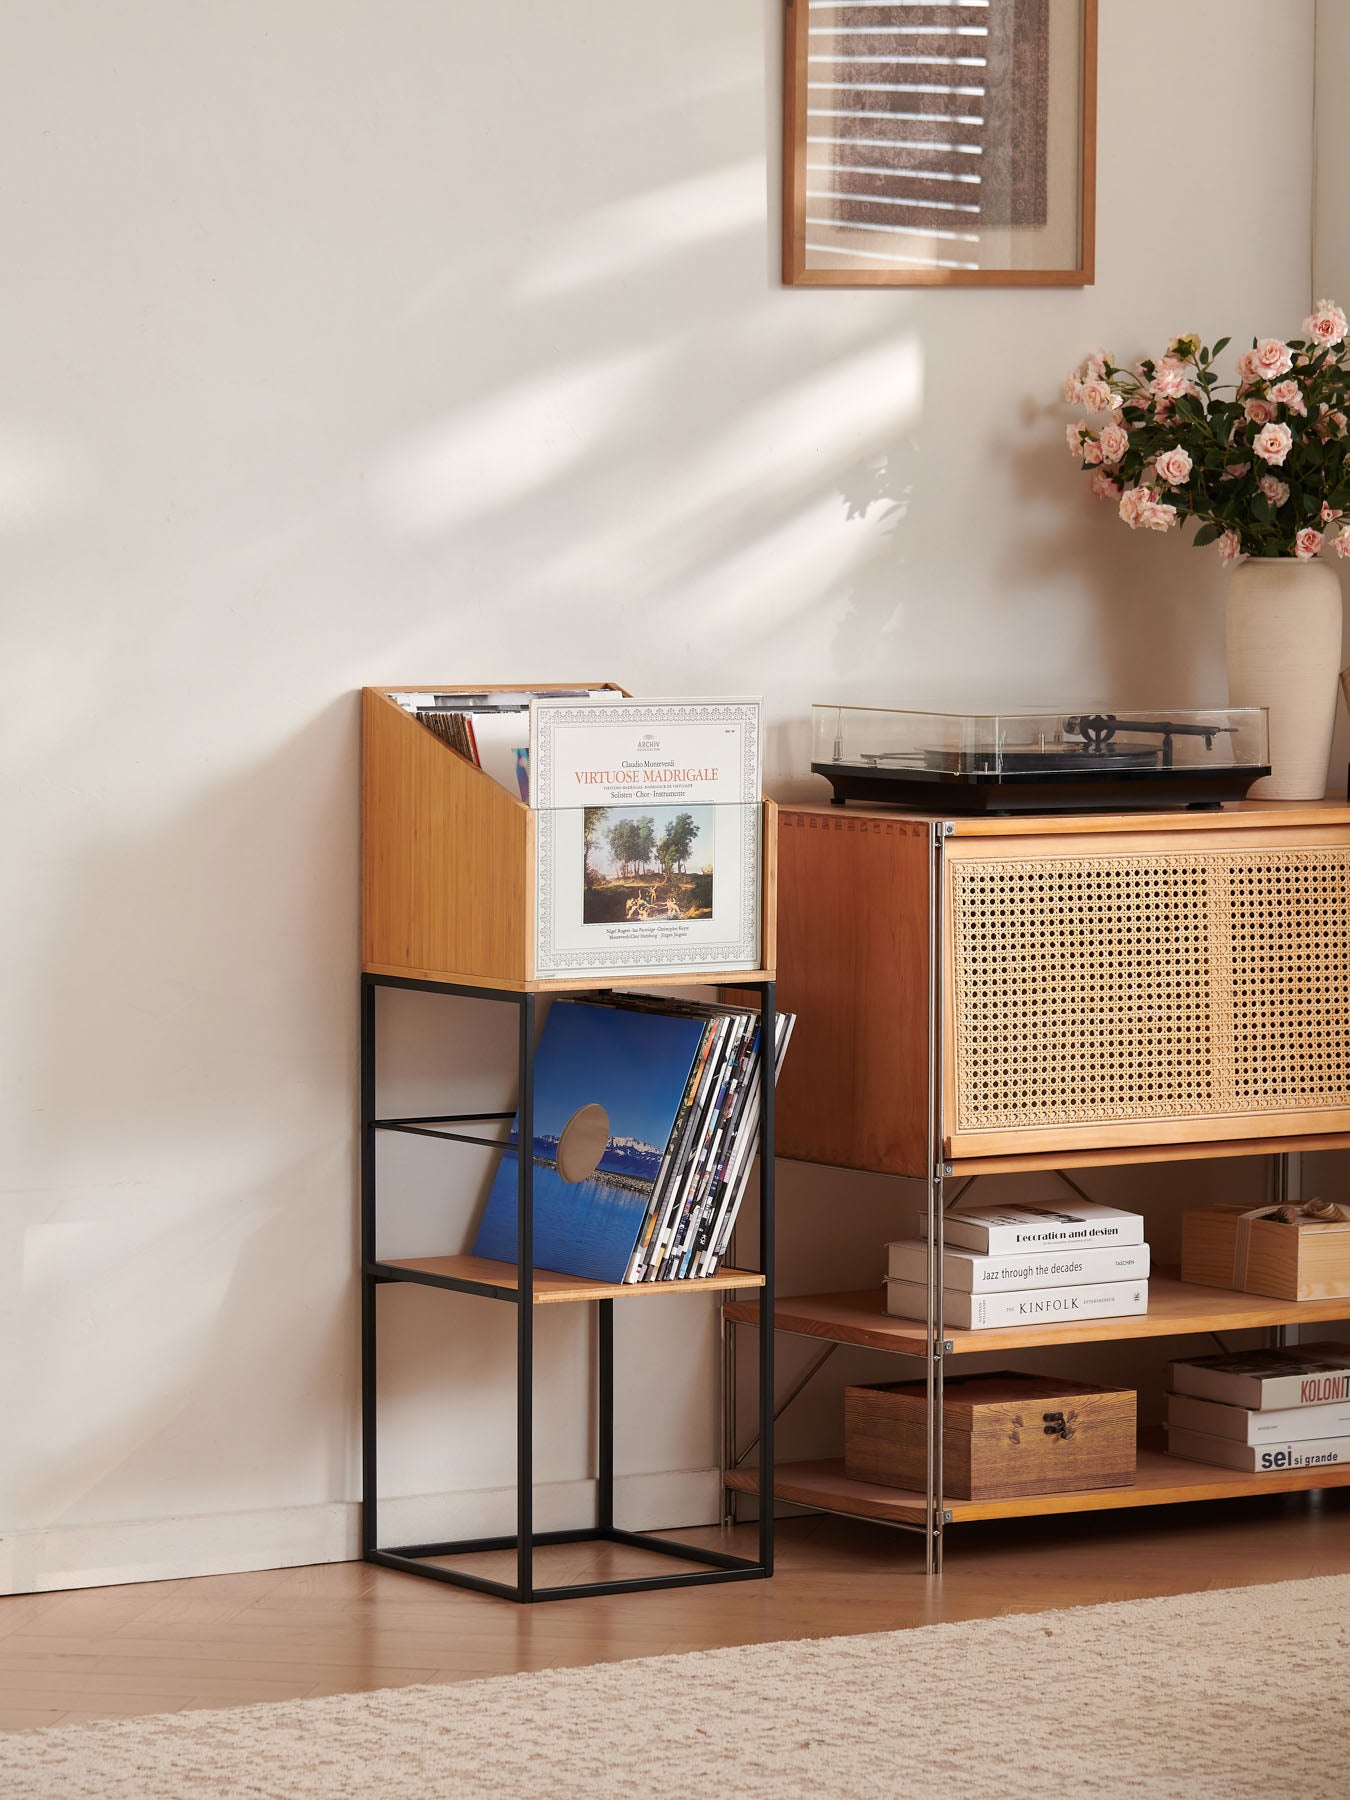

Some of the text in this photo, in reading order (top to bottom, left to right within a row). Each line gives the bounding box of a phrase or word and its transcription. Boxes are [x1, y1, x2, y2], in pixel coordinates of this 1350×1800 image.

[575, 768, 719, 784] VIRTUOSE MADRIGALE
[610, 790, 686, 799] Solisten Chor Instrumente
[1016, 1233, 1066, 1243] Decoration
[1068, 1229, 1087, 1238] and
[1089, 1227, 1119, 1237] design
[982, 1262, 1083, 1280] Jazz through the decades
[1019, 1298, 1079, 1314] KINFOLK
[1261, 1445, 1338, 1469] sei si grande
